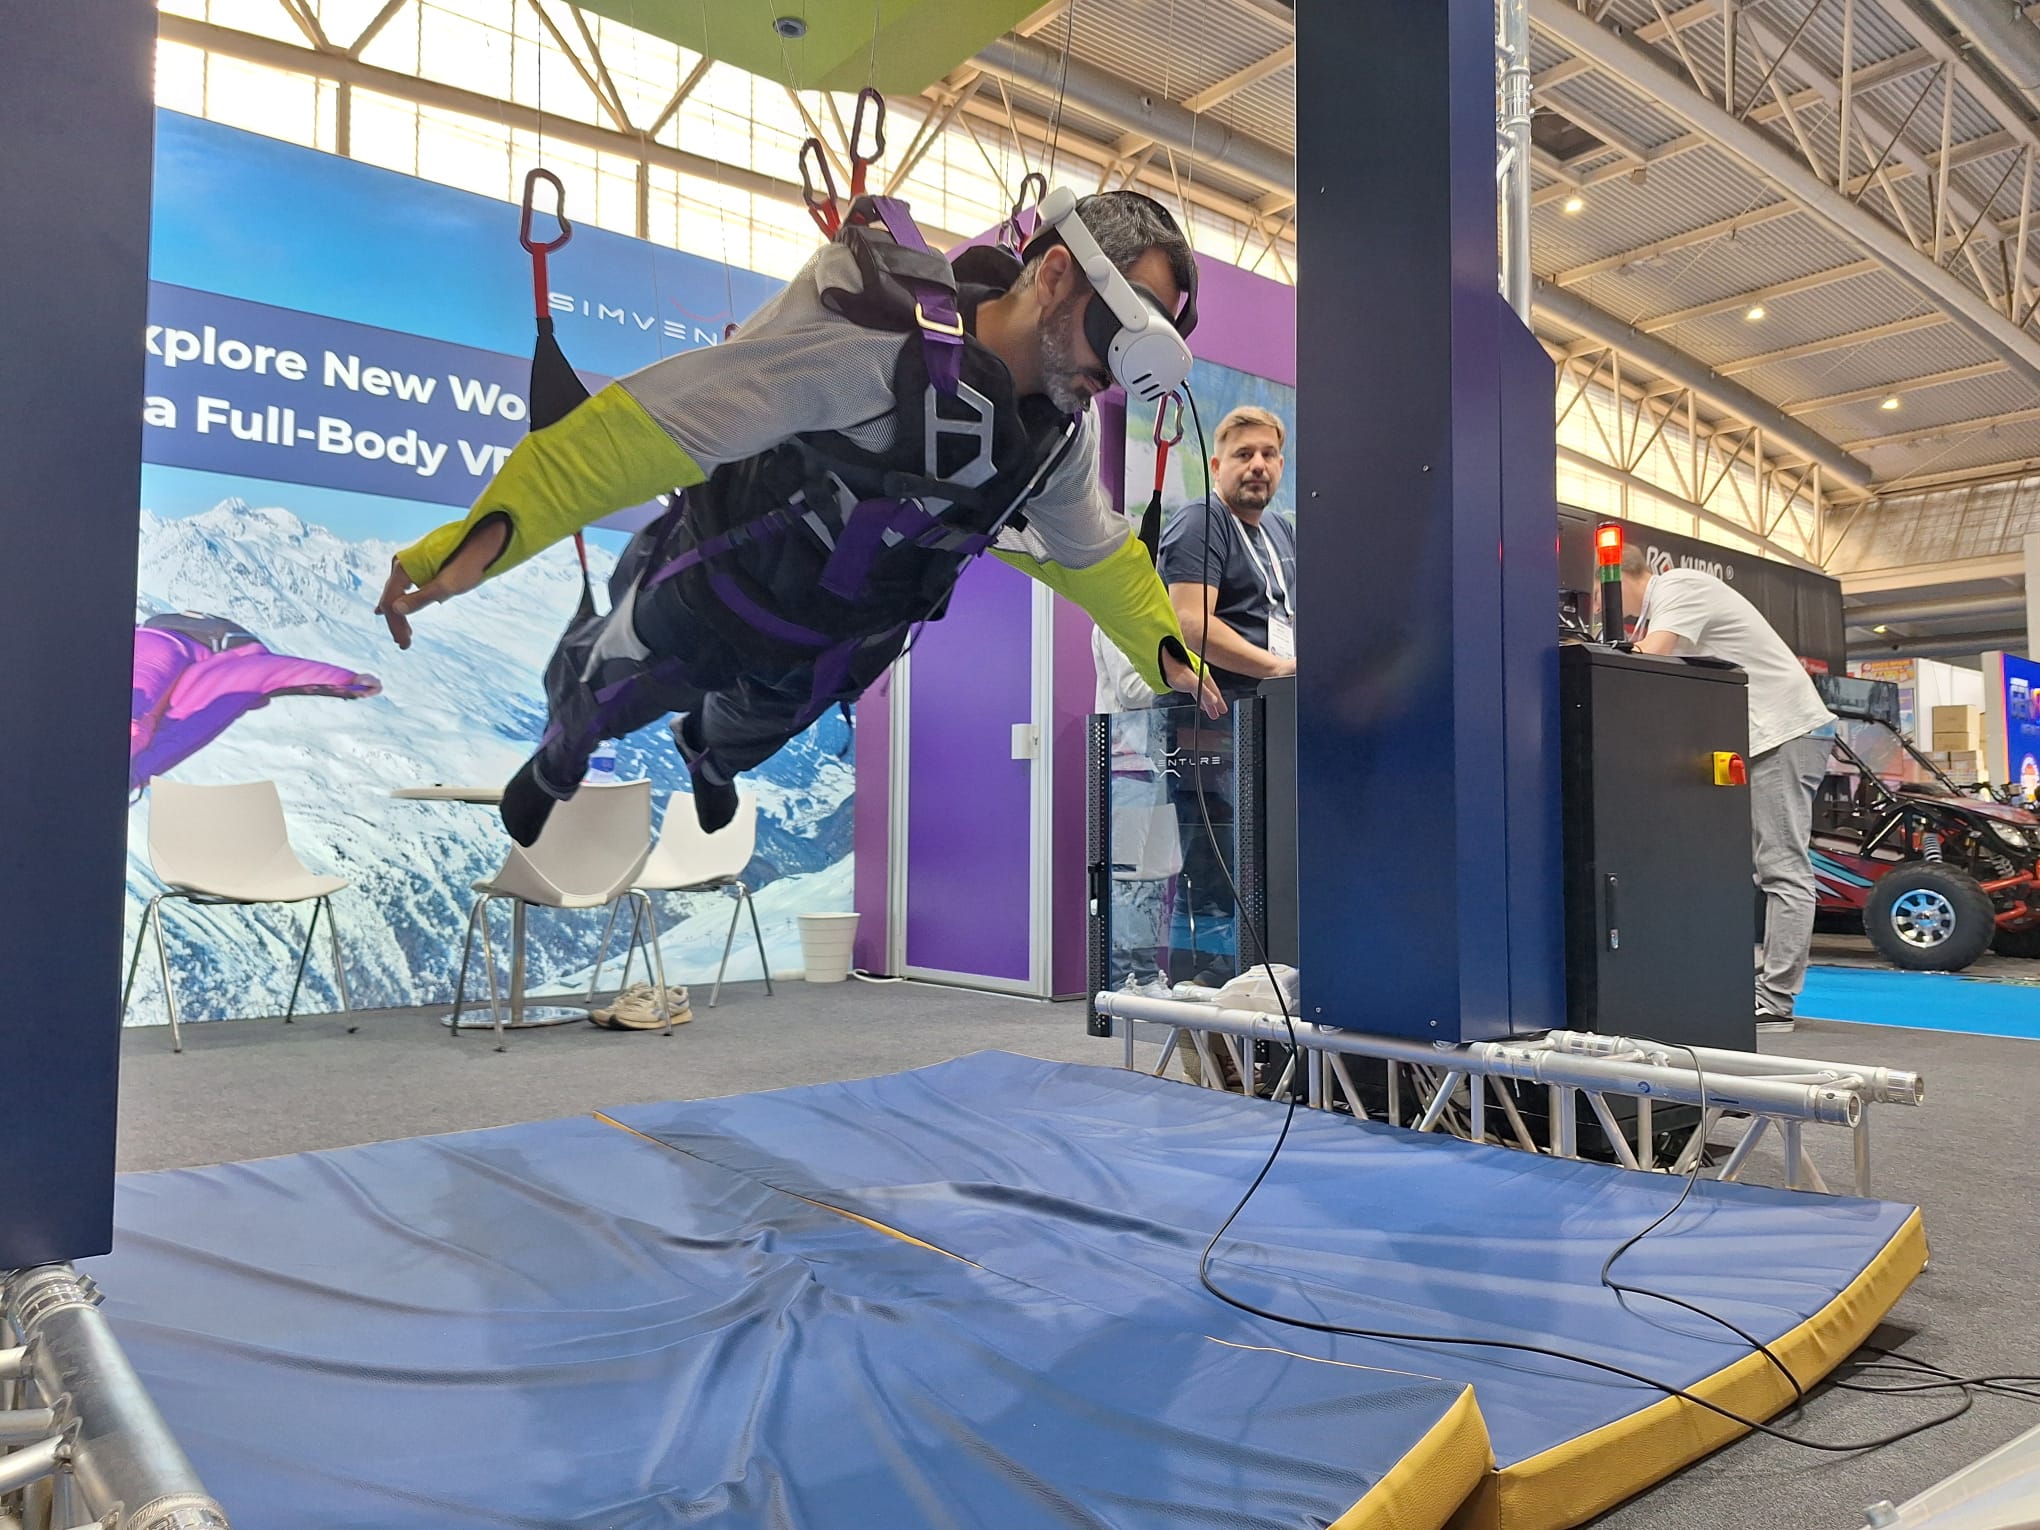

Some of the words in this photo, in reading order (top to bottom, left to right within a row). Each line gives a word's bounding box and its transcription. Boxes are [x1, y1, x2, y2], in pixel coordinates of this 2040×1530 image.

[324, 350, 437, 404] New
[448, 374, 529, 422] Wo
[143, 395, 177, 429] a
[197, 395, 448, 477] Full-Body
